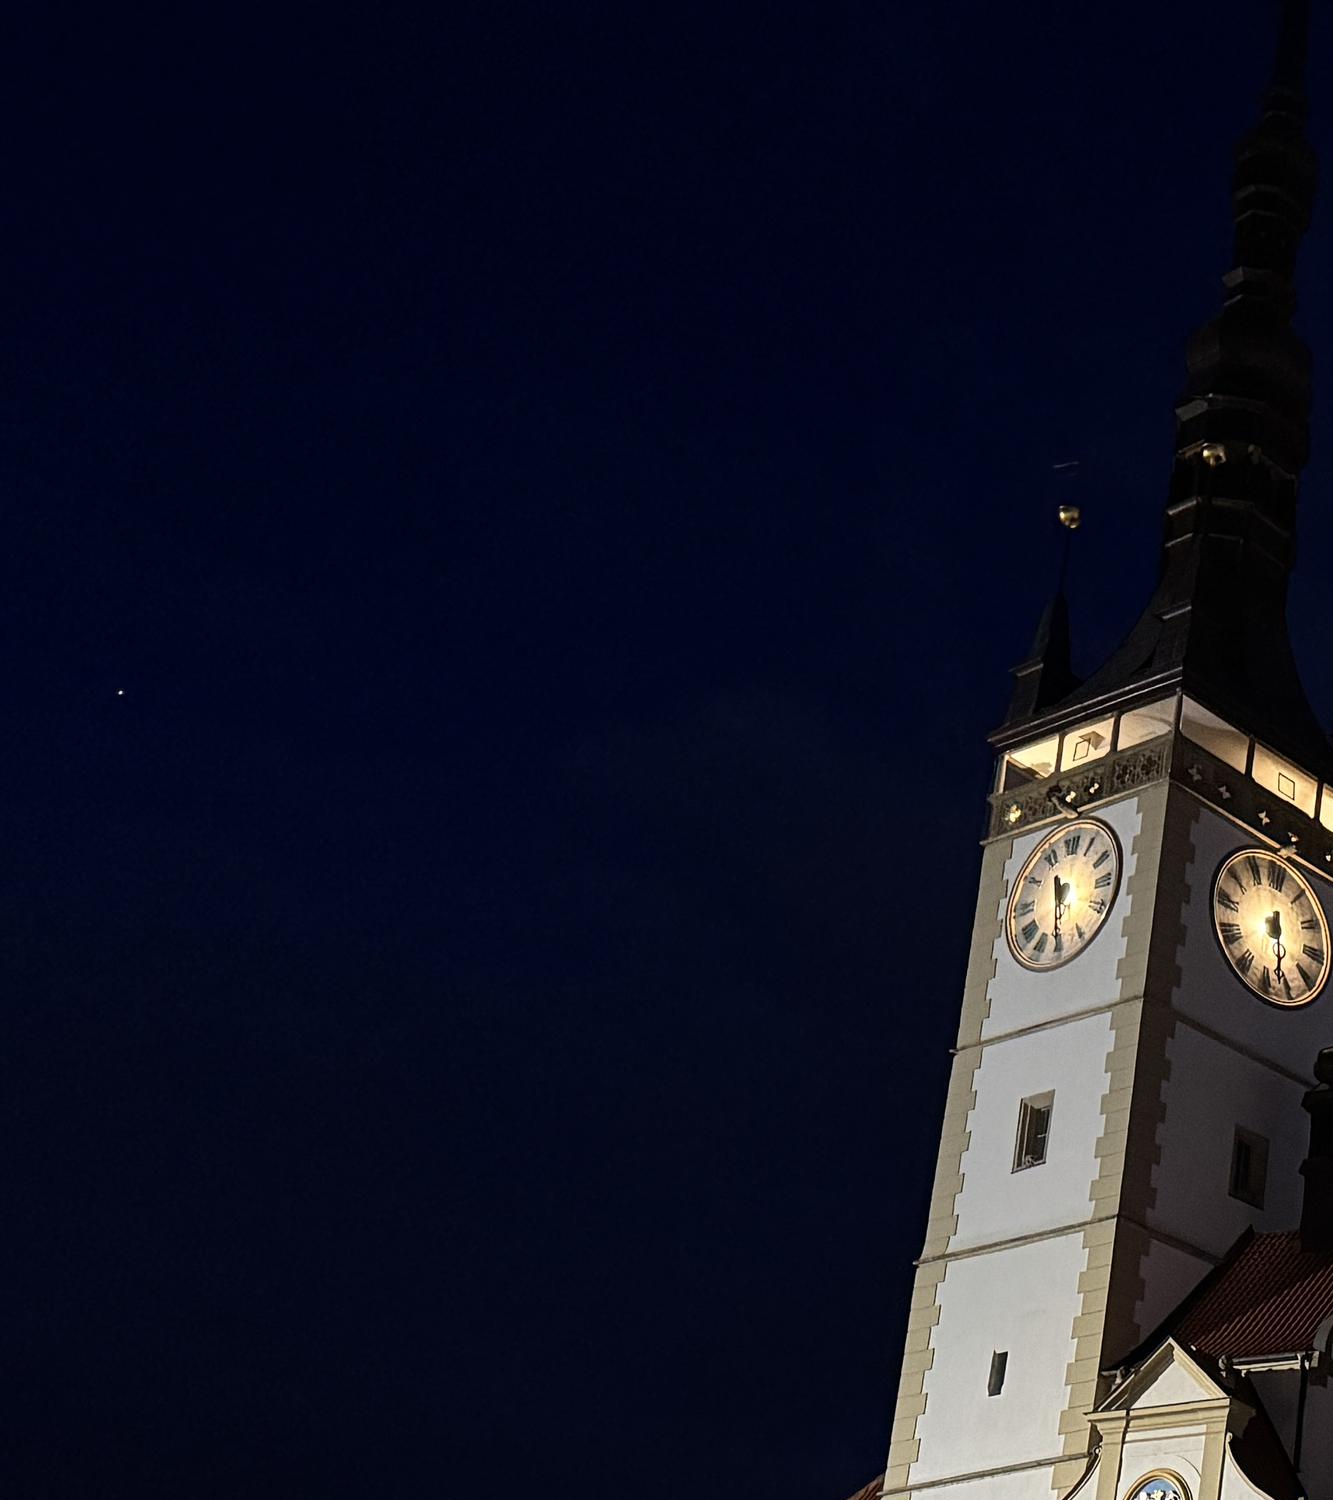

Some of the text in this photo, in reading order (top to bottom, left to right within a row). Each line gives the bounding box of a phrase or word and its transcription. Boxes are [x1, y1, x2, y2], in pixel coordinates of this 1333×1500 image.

[1084, 836, 1096, 856] I
[1093, 850, 1111, 869] II
[1095, 872, 1112, 889] III
